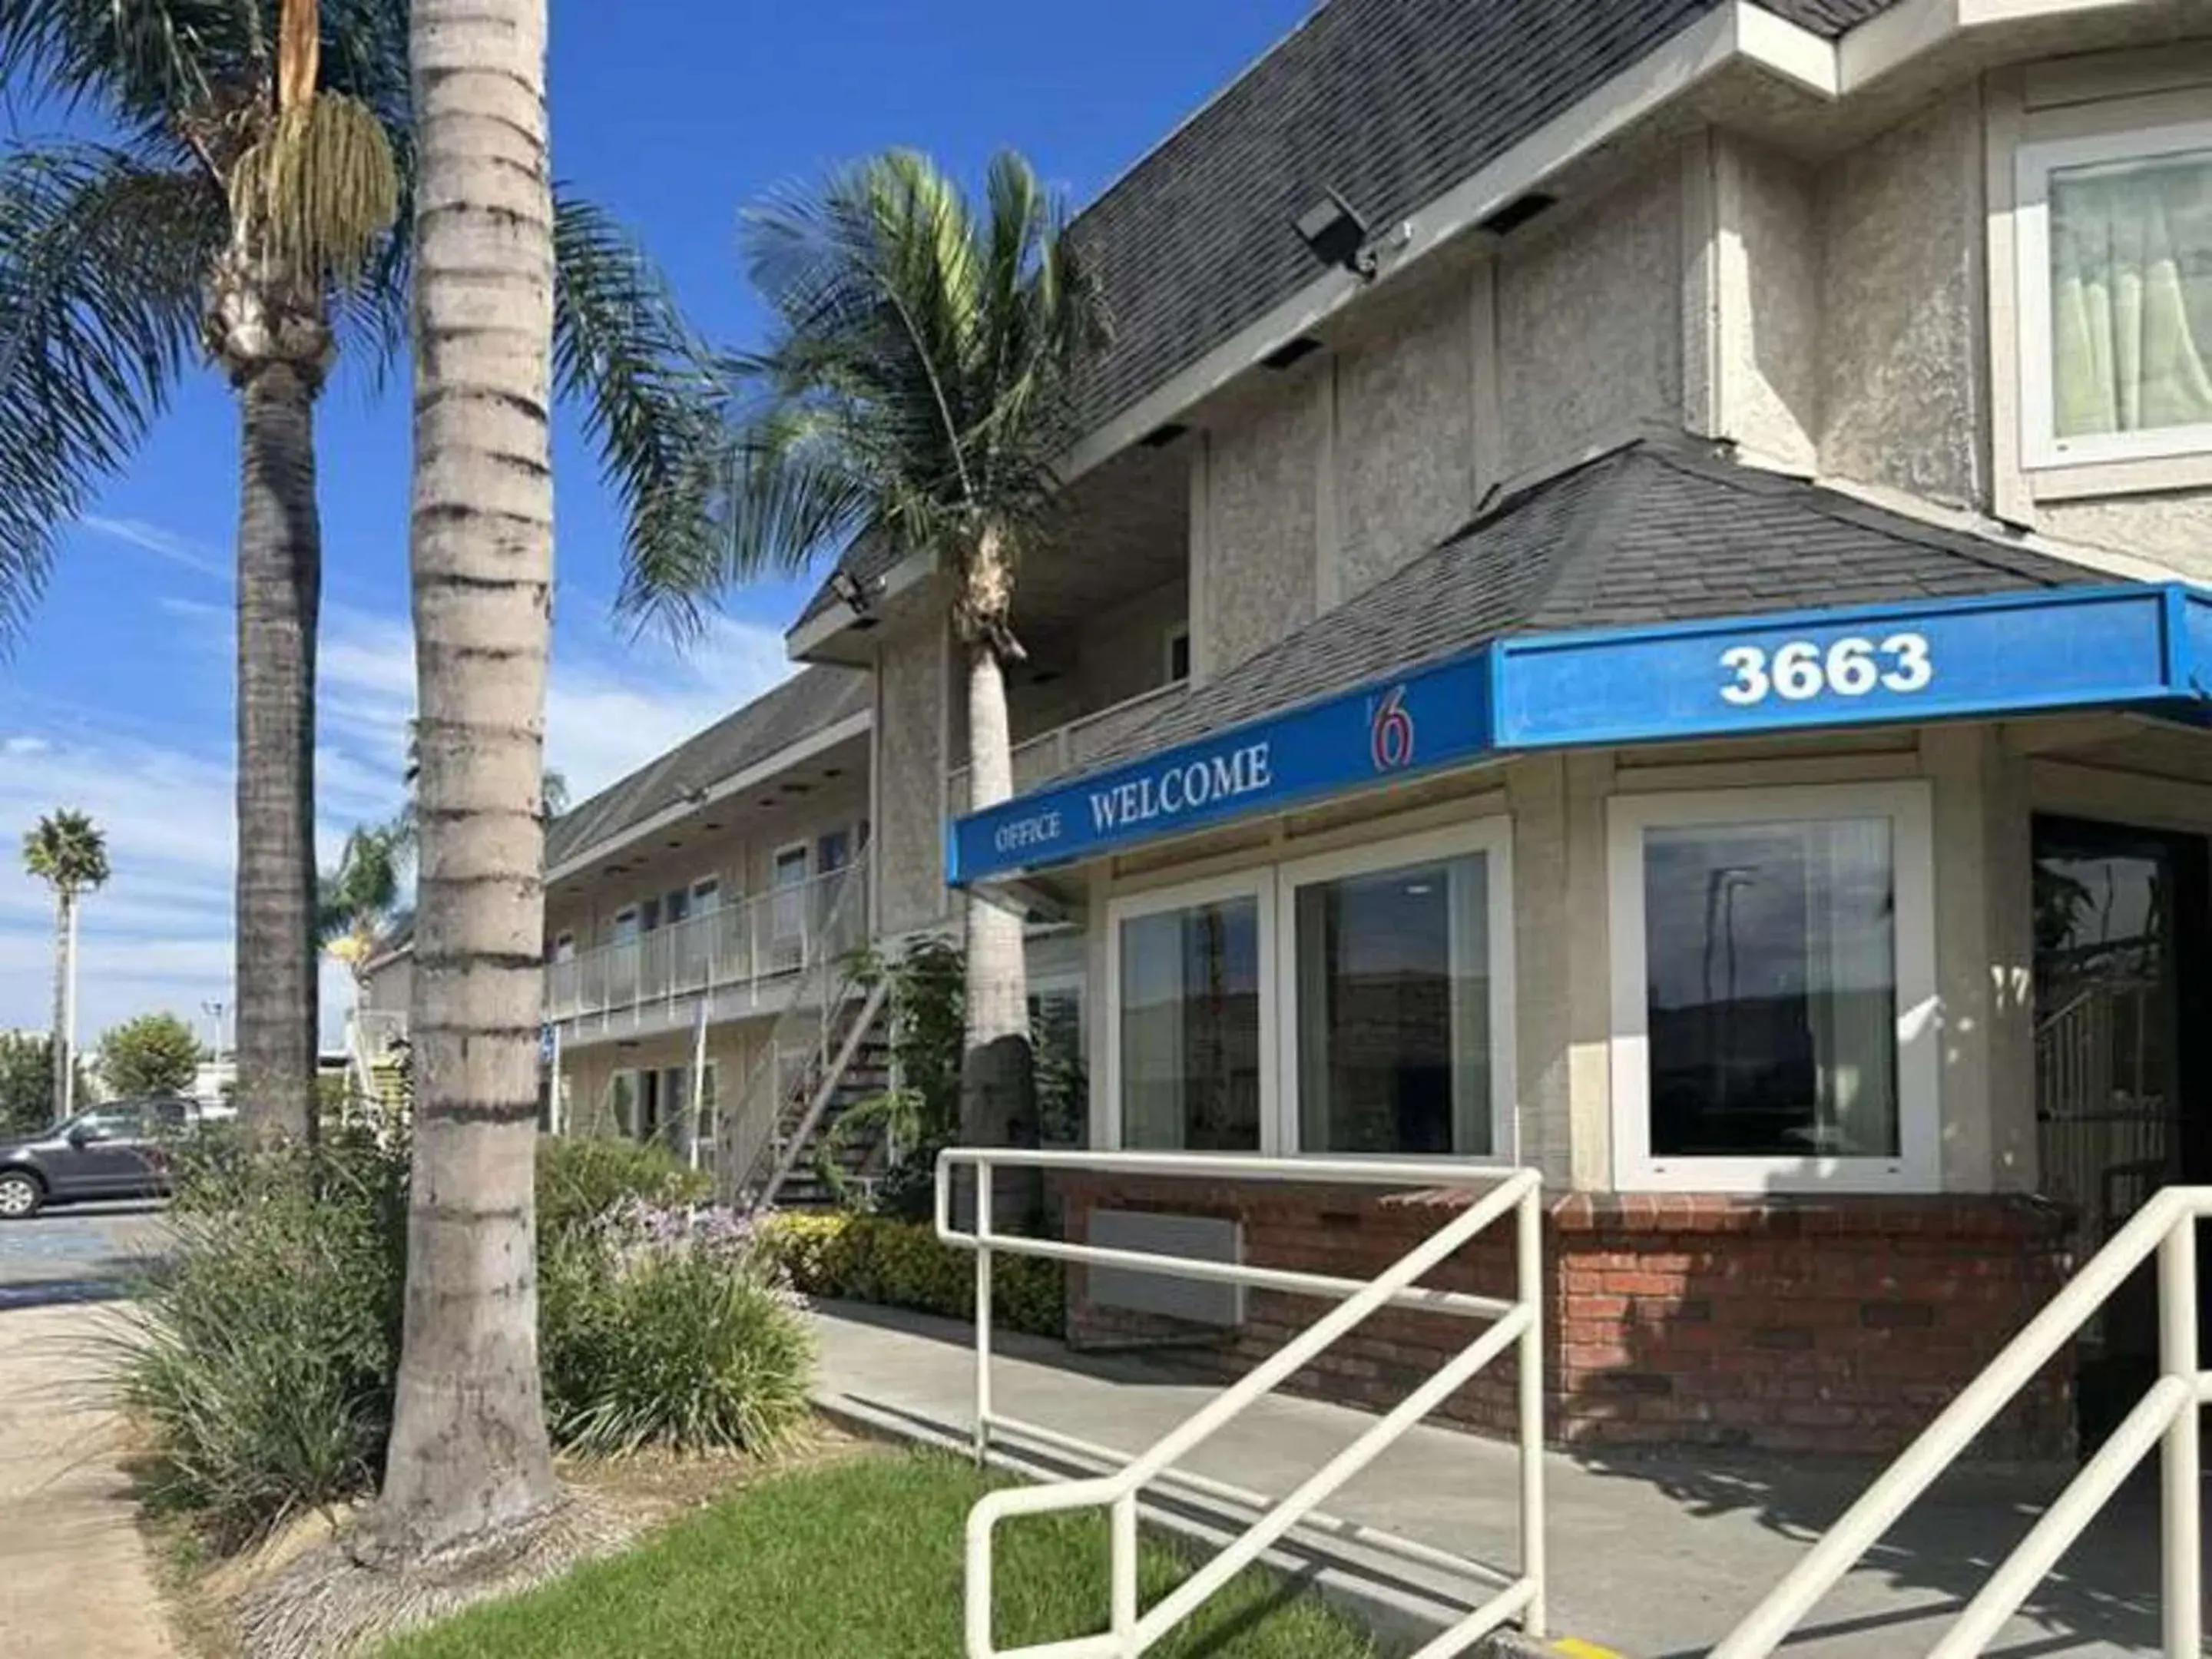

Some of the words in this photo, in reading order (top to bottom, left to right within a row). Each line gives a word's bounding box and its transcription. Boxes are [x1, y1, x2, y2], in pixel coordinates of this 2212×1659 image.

[1720, 634, 1932, 703] 3663
[1371, 684, 1413, 771] 6
[995, 812, 1061, 851] OFFICE
[1089, 743, 1271, 830] WELCOME
